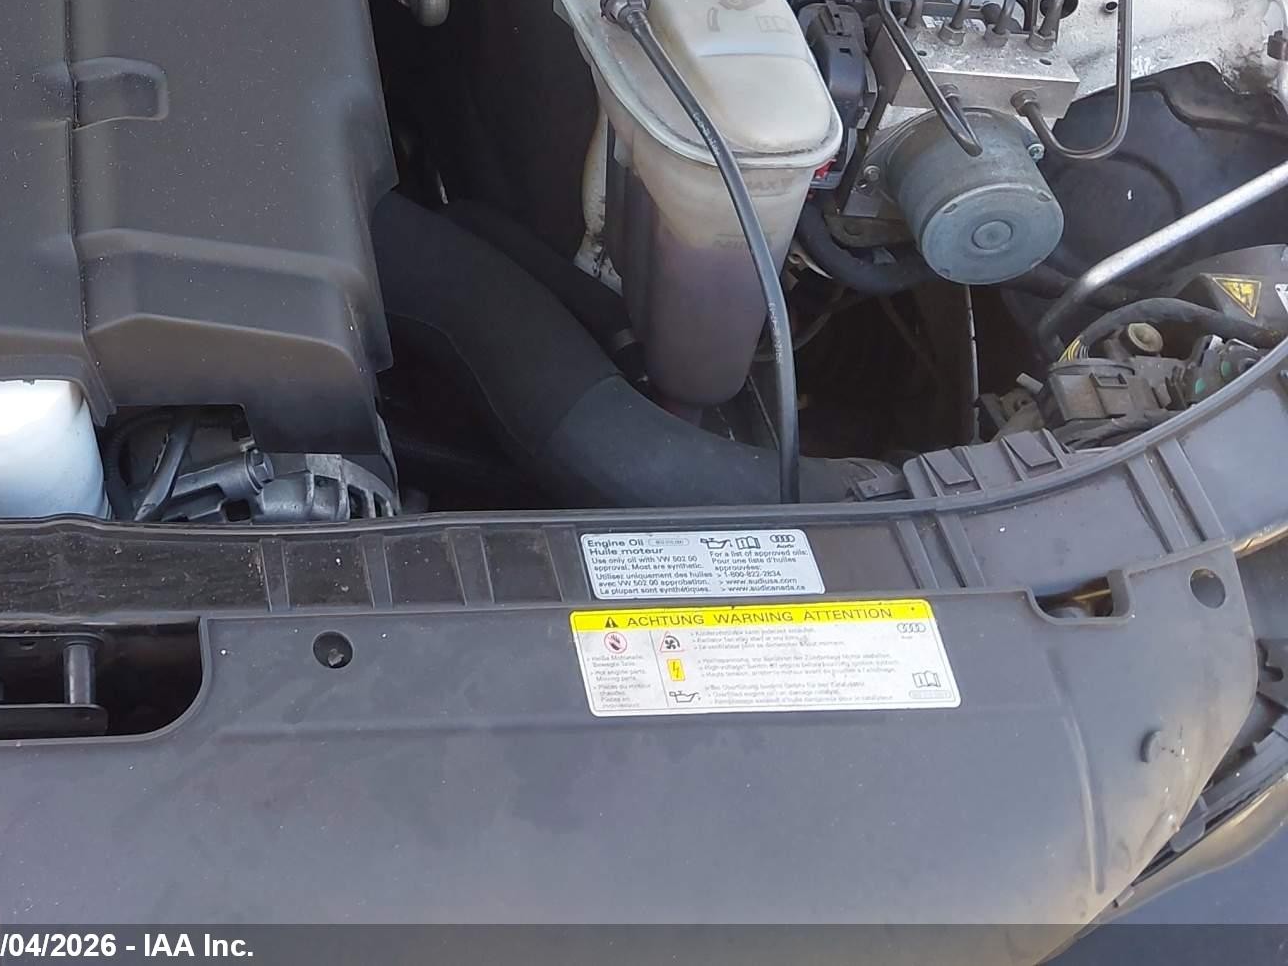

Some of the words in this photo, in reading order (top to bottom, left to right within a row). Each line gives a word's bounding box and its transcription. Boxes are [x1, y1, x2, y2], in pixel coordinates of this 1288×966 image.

[587, 539, 626, 548] Engine
[628, 538, 644, 546] Oil
[754, 549, 790, 557] approved
[608, 557, 625, 565] only
[673, 555, 686, 563] 502
[712, 557, 730, 565] Pour
[748, 556, 764, 564] liste
[594, 564, 630, 572] approval.
[667, 562, 704, 571] synthetic.
[626, 572, 672, 581] uniquement
[660, 579, 710, 588] approbation.
[611, 587, 639, 596] plupart
[627, 614, 704, 628] ACHTUNG
[713, 611, 794, 625] WARNING
[803, 607, 893, 622] ATTENTION
